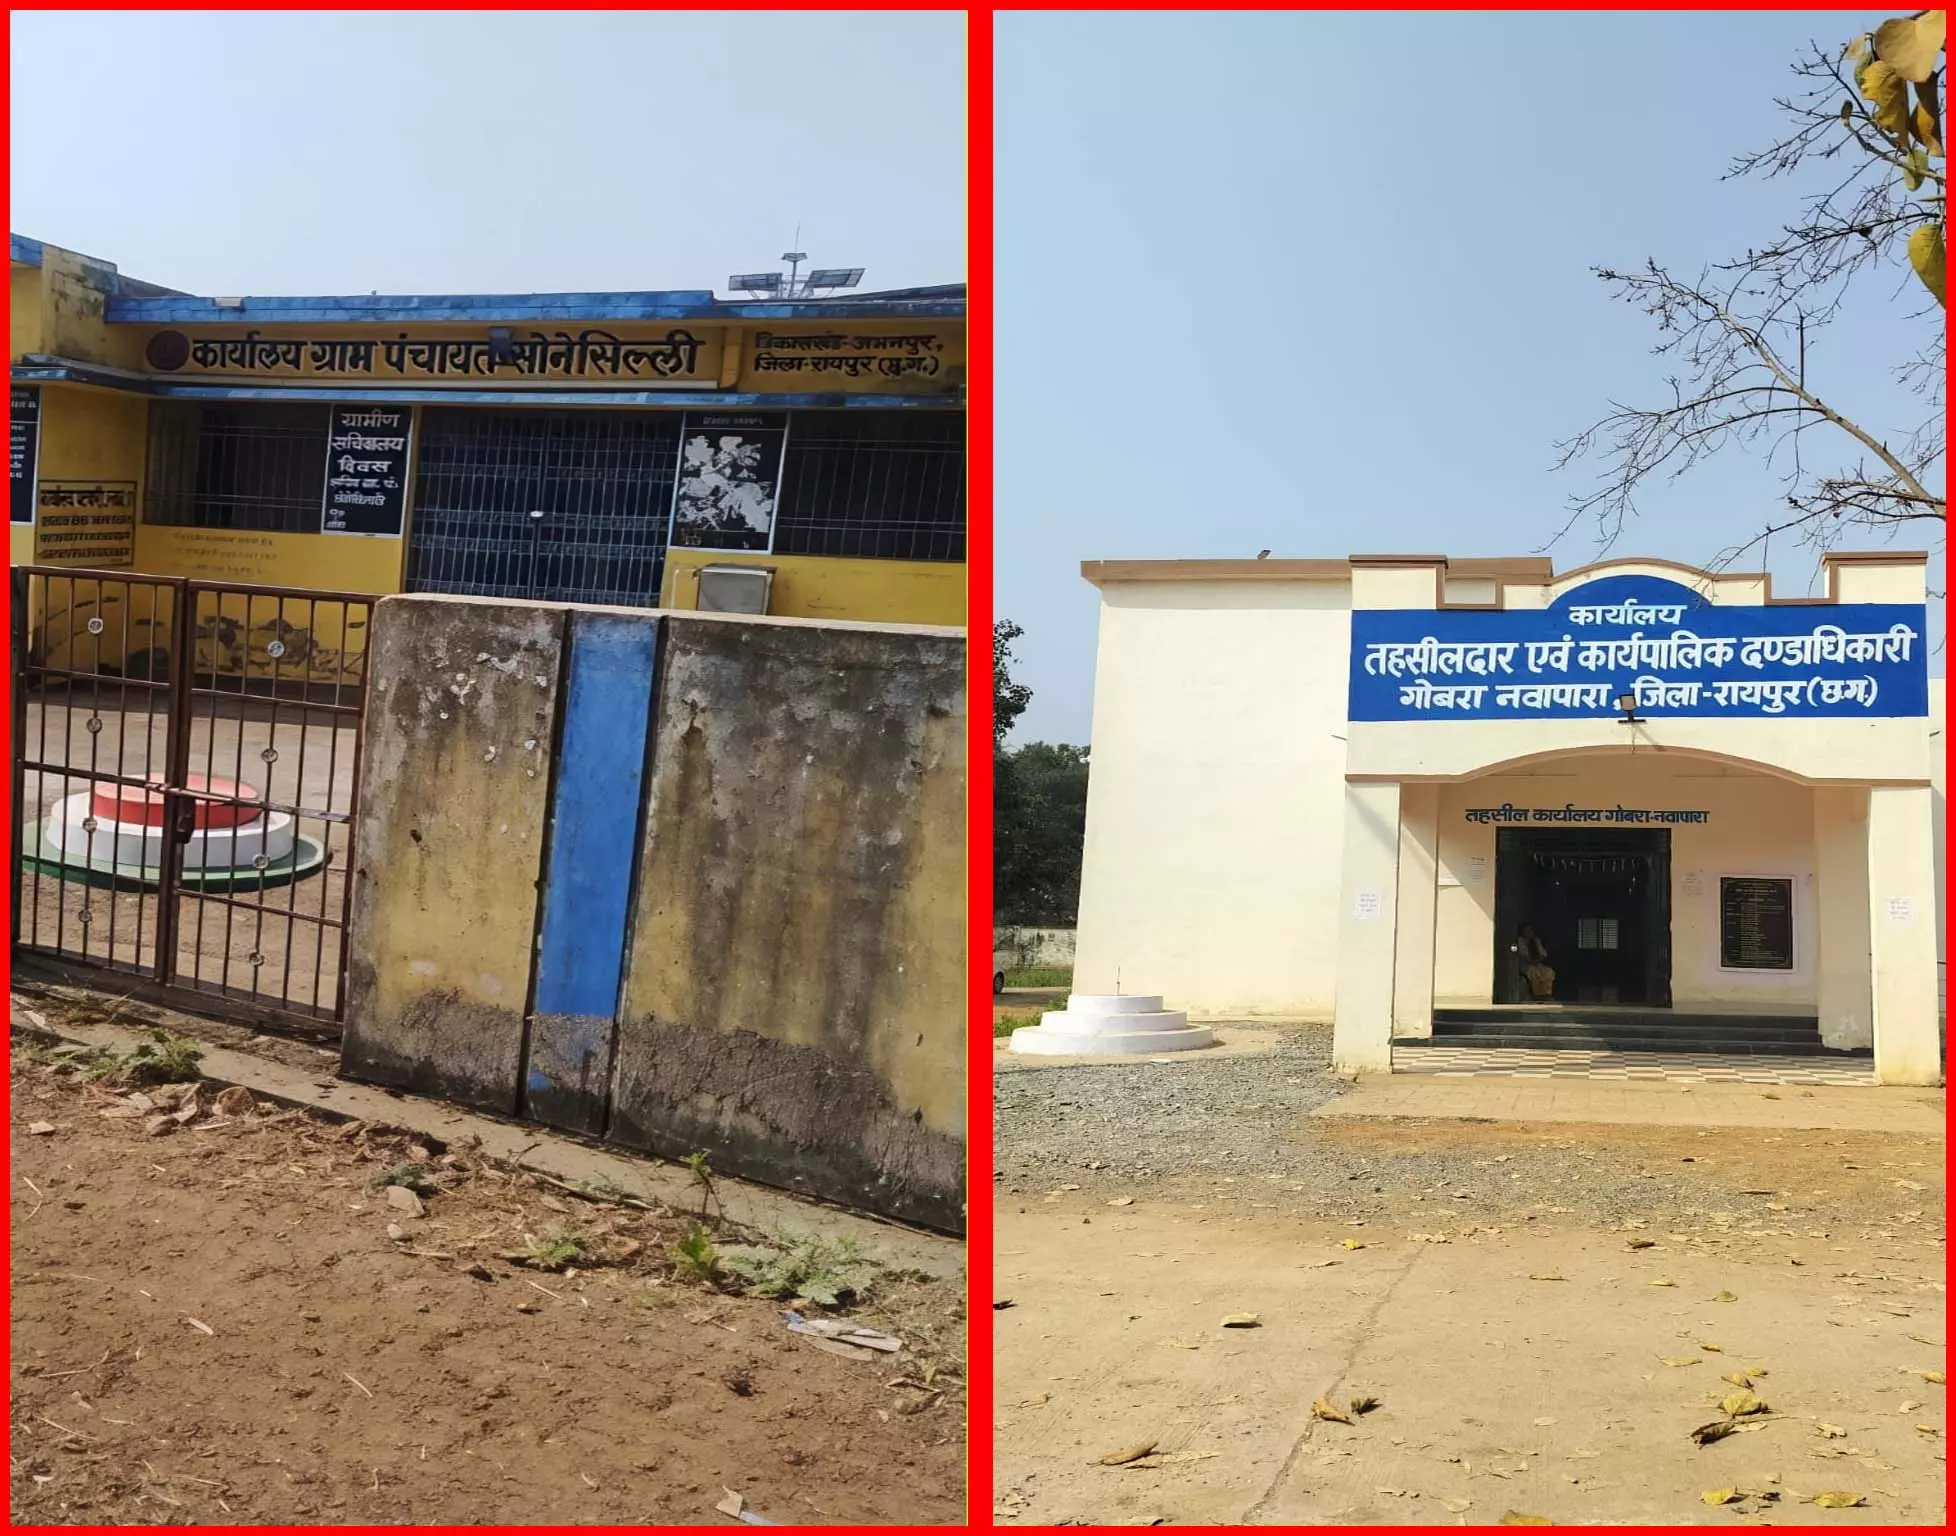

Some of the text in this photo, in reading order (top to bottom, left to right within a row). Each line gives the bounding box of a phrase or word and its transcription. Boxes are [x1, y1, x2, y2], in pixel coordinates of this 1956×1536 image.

[192, 329, 705, 376] कार्यालय ग्राम पंचायत सोनेसिल्ली
[340, 408, 401, 428] ग्रामीण
[331, 432, 406, 452] सचिवालय
[336, 454, 393, 474] दिवस
[1568, 598, 1688, 627] कार्यालय
[1364, 624, 1918, 678] तहसीलदार एवं कार्यपालिक दण्डाधिकारी
[1399, 678, 1489, 711] गोबरा
[1465, 802, 1530, 824] तहसील
[1532, 803, 1602, 823] कार्यालय
